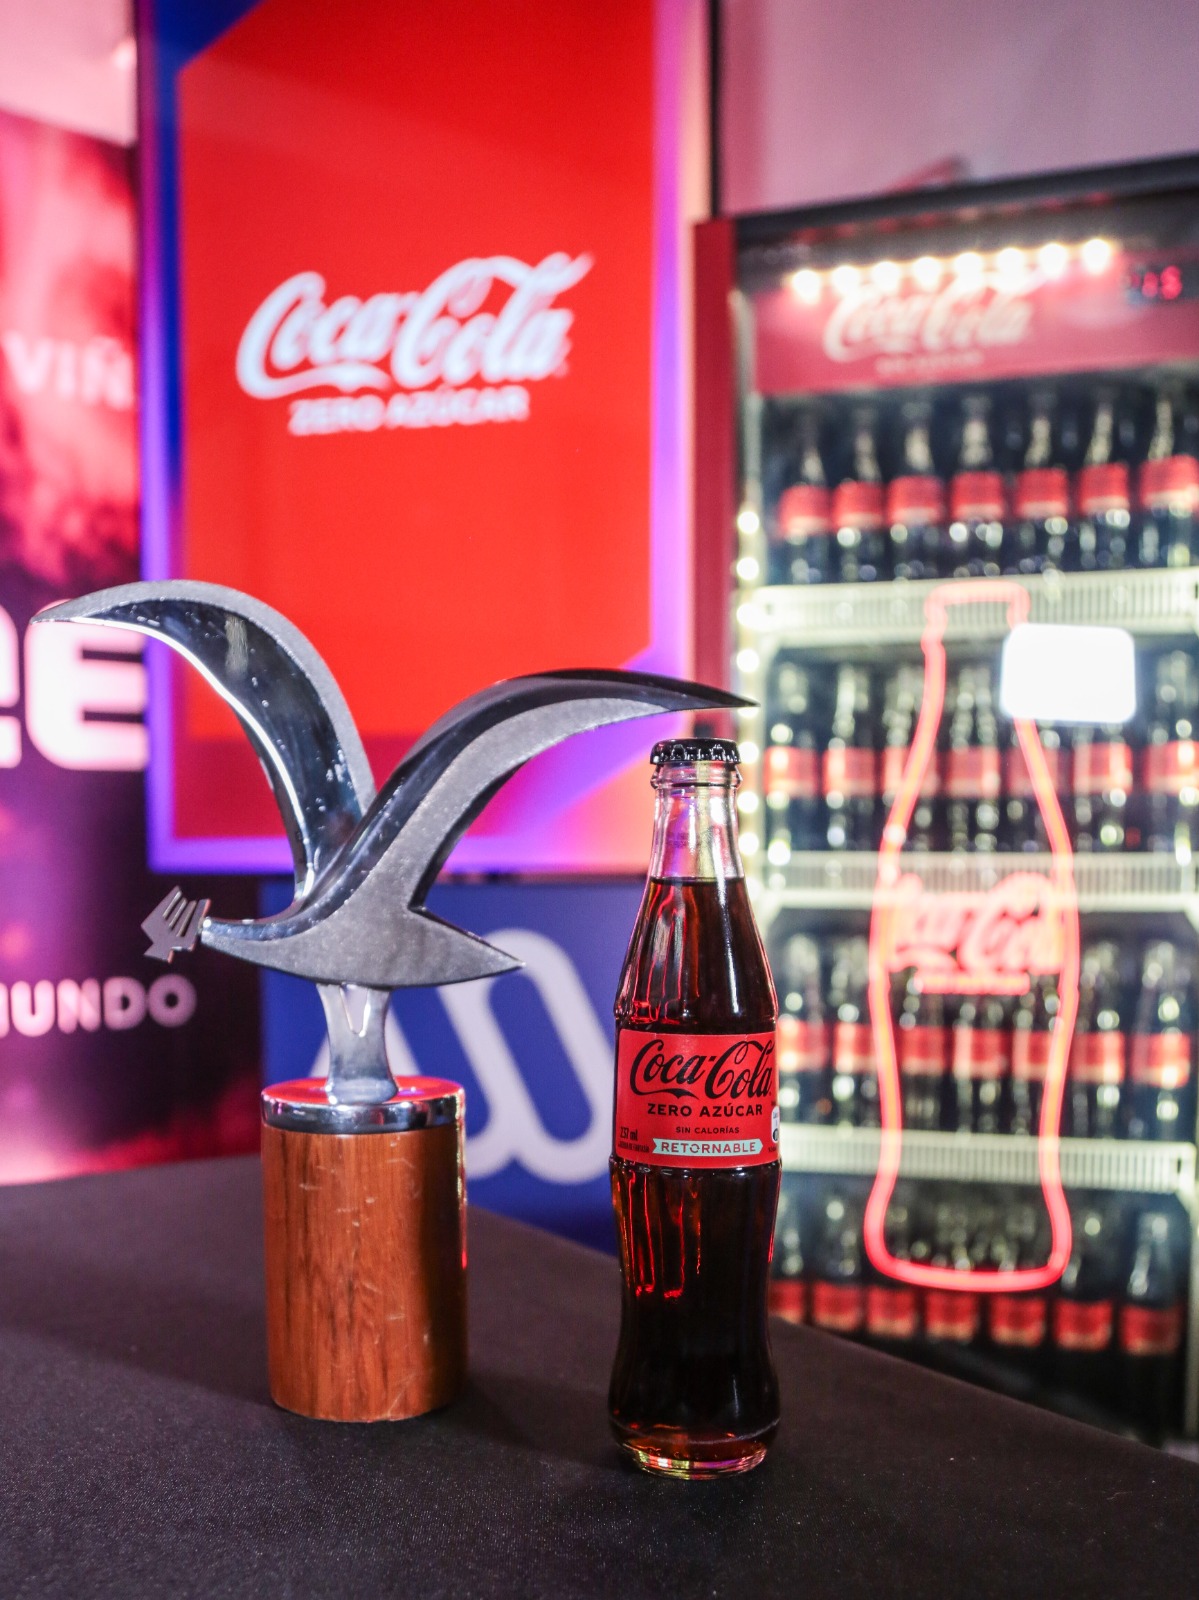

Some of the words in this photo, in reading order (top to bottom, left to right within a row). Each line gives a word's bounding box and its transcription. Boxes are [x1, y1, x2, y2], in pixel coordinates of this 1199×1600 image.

[235, 251, 594, 399] Coca-Cola
[288, 393, 385, 436] ZERO
[0, 973, 197, 1037] UNDO
[629, 1038, 775, 1100] Coca-Cola
[647, 1103, 693, 1117] ZERO
[699, 1102, 763, 1118] AZÚCAR
[675, 1126, 691, 1134] SIN
[694, 1125, 740, 1135] CALORÍAS
[661, 1141, 756, 1153] RETORNABLE
